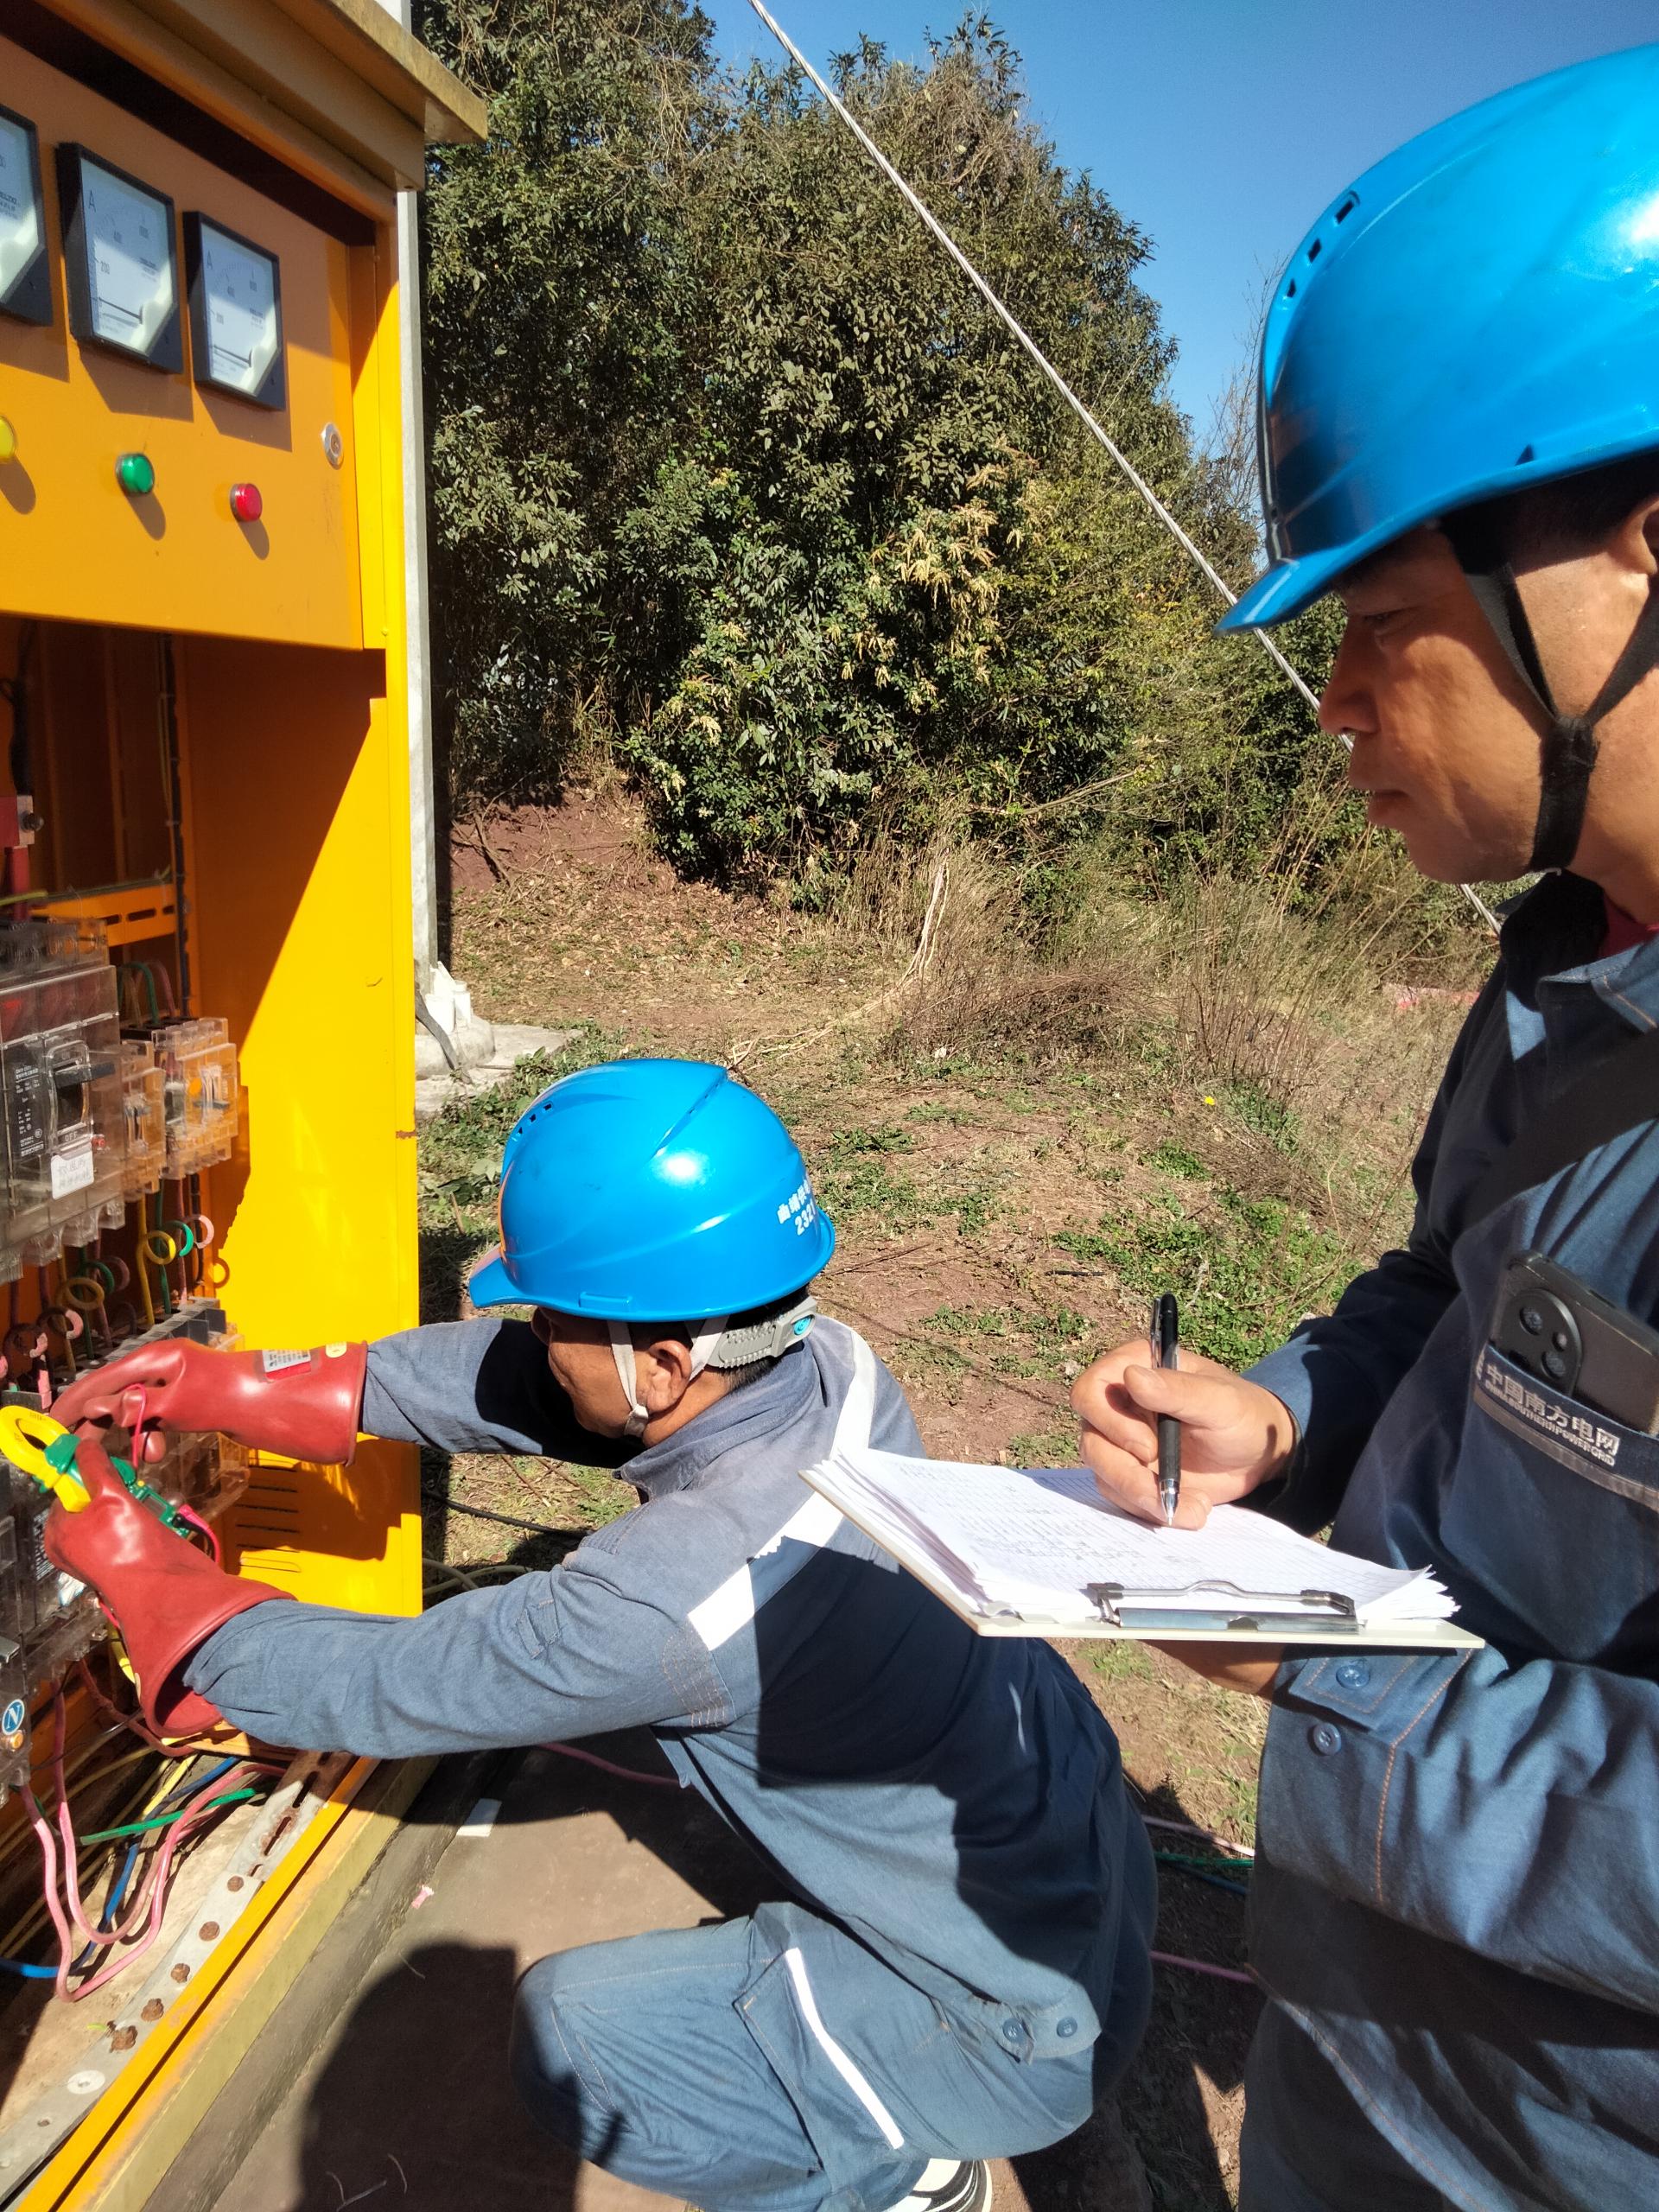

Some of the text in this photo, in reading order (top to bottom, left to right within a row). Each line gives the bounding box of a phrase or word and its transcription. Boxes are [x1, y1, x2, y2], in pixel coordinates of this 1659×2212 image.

[89, 190, 97, 213] A
[65, 1132, 78, 1142] OFF
[1486, 1364, 1620, 1456] 中国南方电网
[1555, 1427, 1591, 1452] POWER
[1591, 1446, 1615, 1467] GRID
[6, 1705, 21, 1730] N
